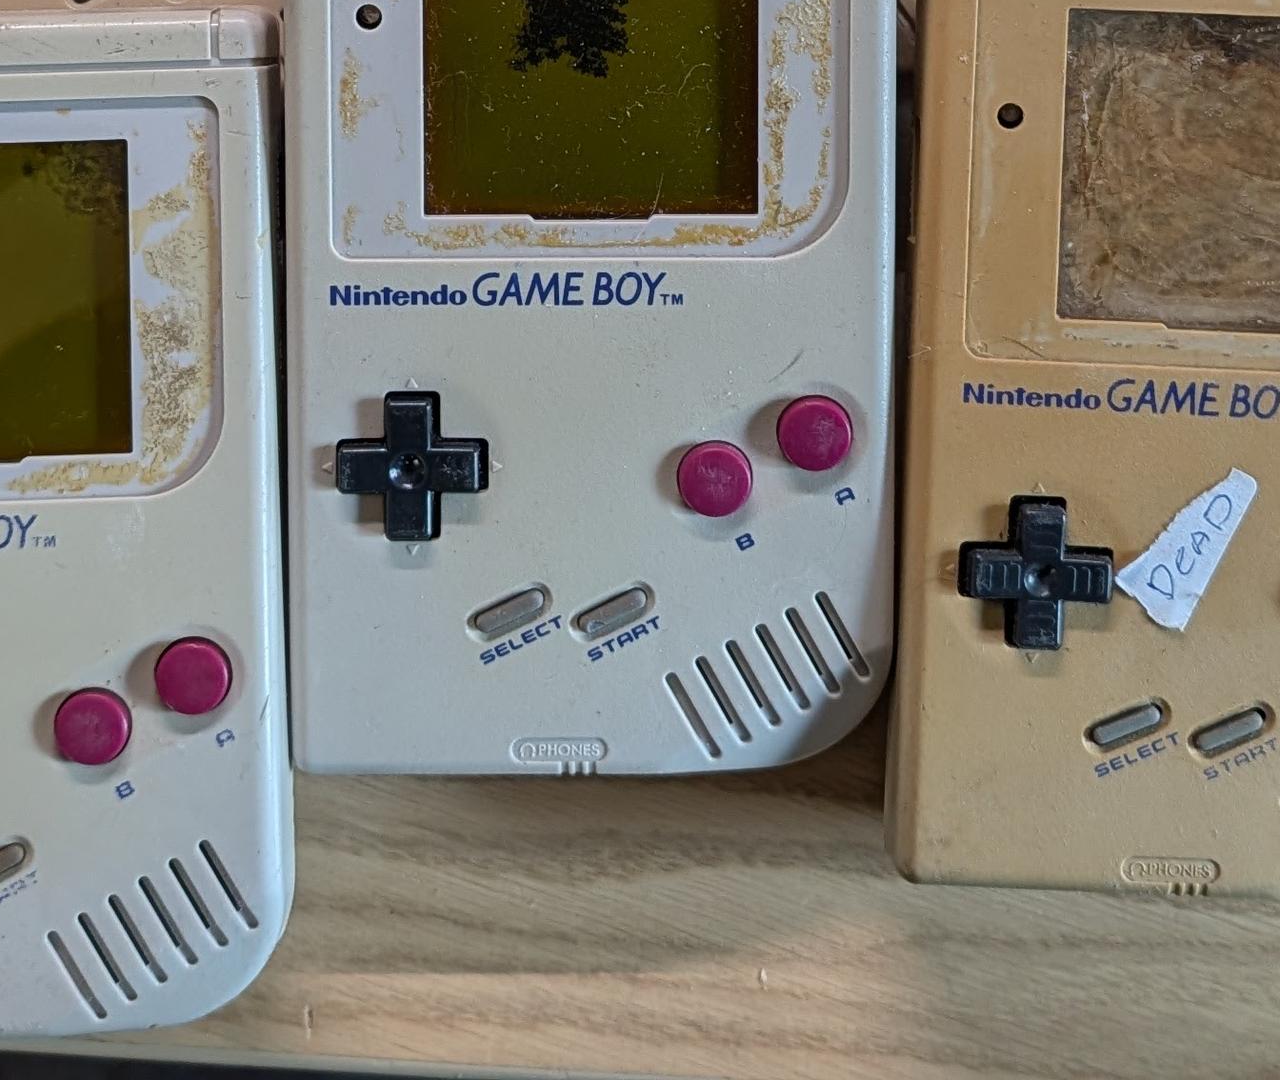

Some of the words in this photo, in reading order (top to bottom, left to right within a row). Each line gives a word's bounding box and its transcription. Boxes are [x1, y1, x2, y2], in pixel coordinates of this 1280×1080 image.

[329, 284, 468, 307] Nintendo
[472, 271, 585, 307] GAME
[592, 271, 667, 307] BOY
[962, 381, 1102, 411] Nintendo
[1106, 378, 1221, 418] GAME
[834, 486, 856, 506] A
[734, 532, 756, 552] B
[1146, 493, 1233, 600] DEAD
[478, 614, 564, 665] SELECT
[586, 614, 661, 662] START
[537, 742, 601, 758] PHONES
[1093, 731, 1180, 779] SELECT
[1202, 737, 1278, 781] START
